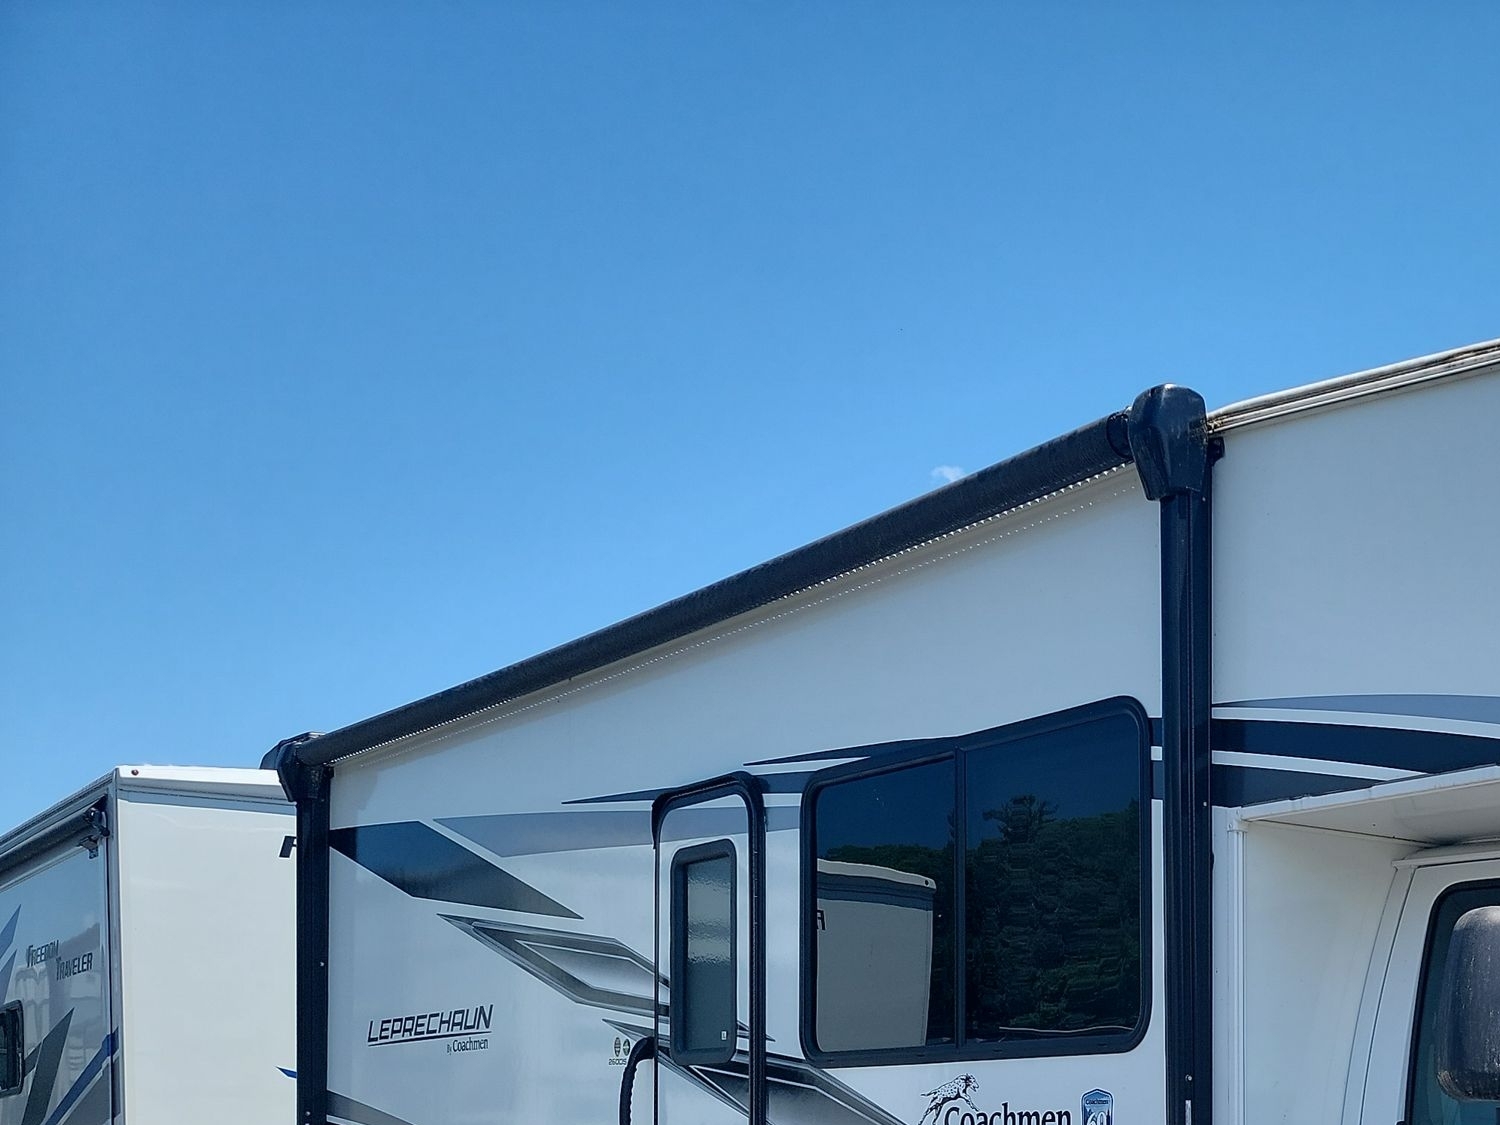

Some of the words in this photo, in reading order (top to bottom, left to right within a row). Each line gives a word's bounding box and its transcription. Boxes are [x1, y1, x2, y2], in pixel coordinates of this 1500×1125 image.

[26, 940, 59, 968] FREEDOM
[56, 952, 93, 981] TRAVELER
[367, 1004, 494, 1043] LEPRECHAUN
[452, 1037, 489, 1053] Coachmen
